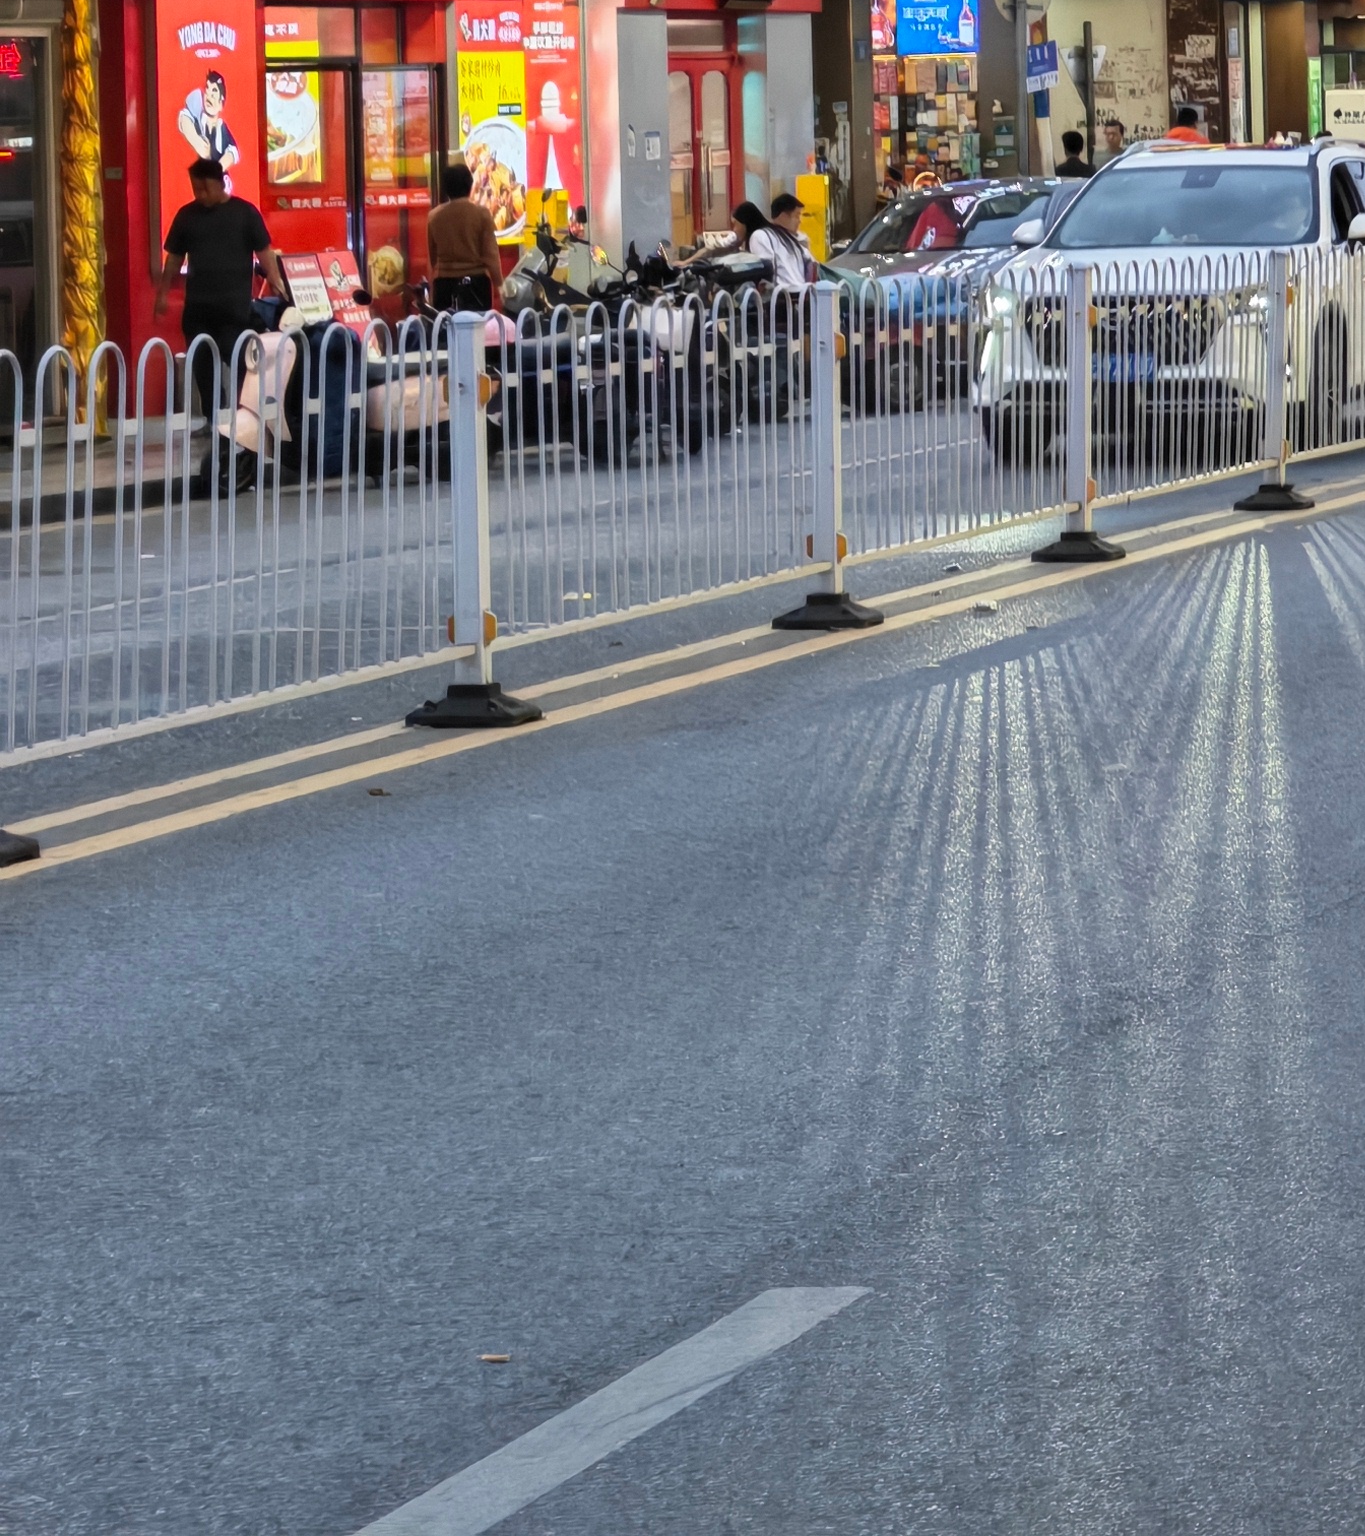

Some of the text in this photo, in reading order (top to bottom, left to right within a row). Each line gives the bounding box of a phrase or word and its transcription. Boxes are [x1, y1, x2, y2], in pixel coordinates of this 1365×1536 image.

[178, 21, 236, 51] YONG DA CHU
